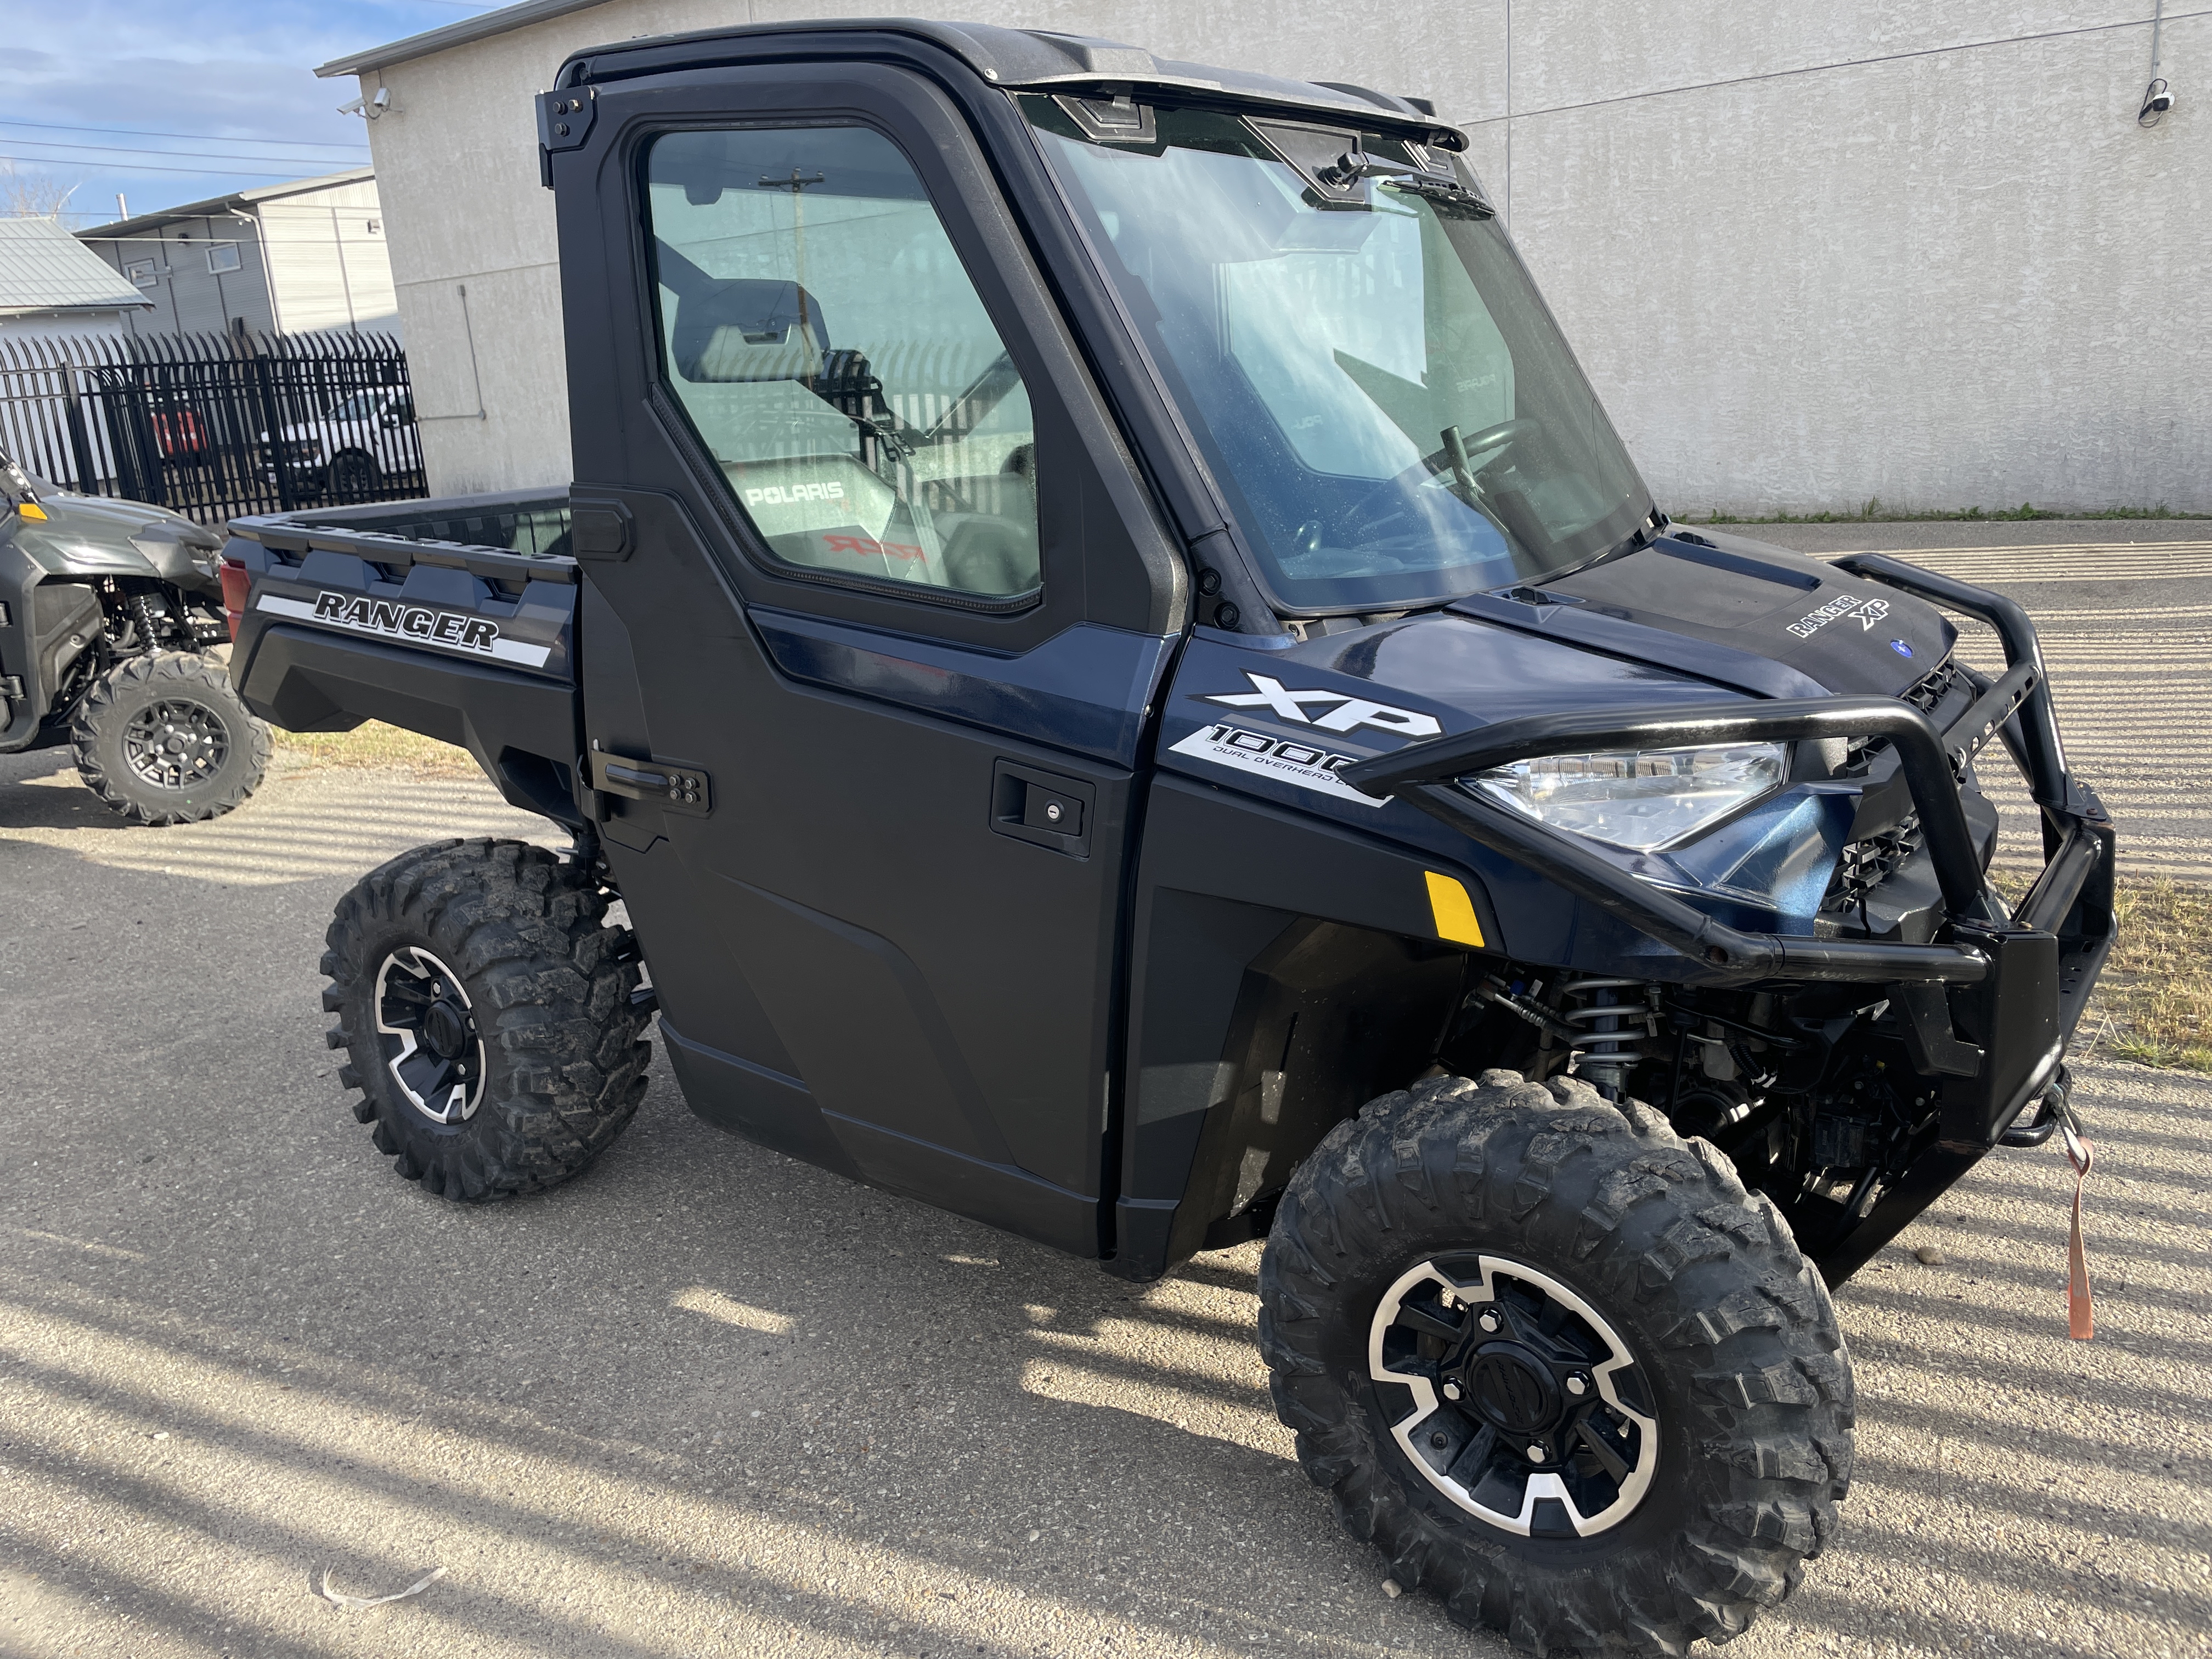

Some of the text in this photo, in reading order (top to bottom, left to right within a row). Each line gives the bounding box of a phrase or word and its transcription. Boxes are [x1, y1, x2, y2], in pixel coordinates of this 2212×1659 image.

[746, 481, 844, 506] POLARIS
[312, 590, 499, 652] RANGER
[1786, 595, 1863, 638] RANGER
[1848, 599, 1889, 631] XP
[1196, 669, 1444, 739] XP
[1212, 746, 1334, 781] DUAL OVERHEAD
